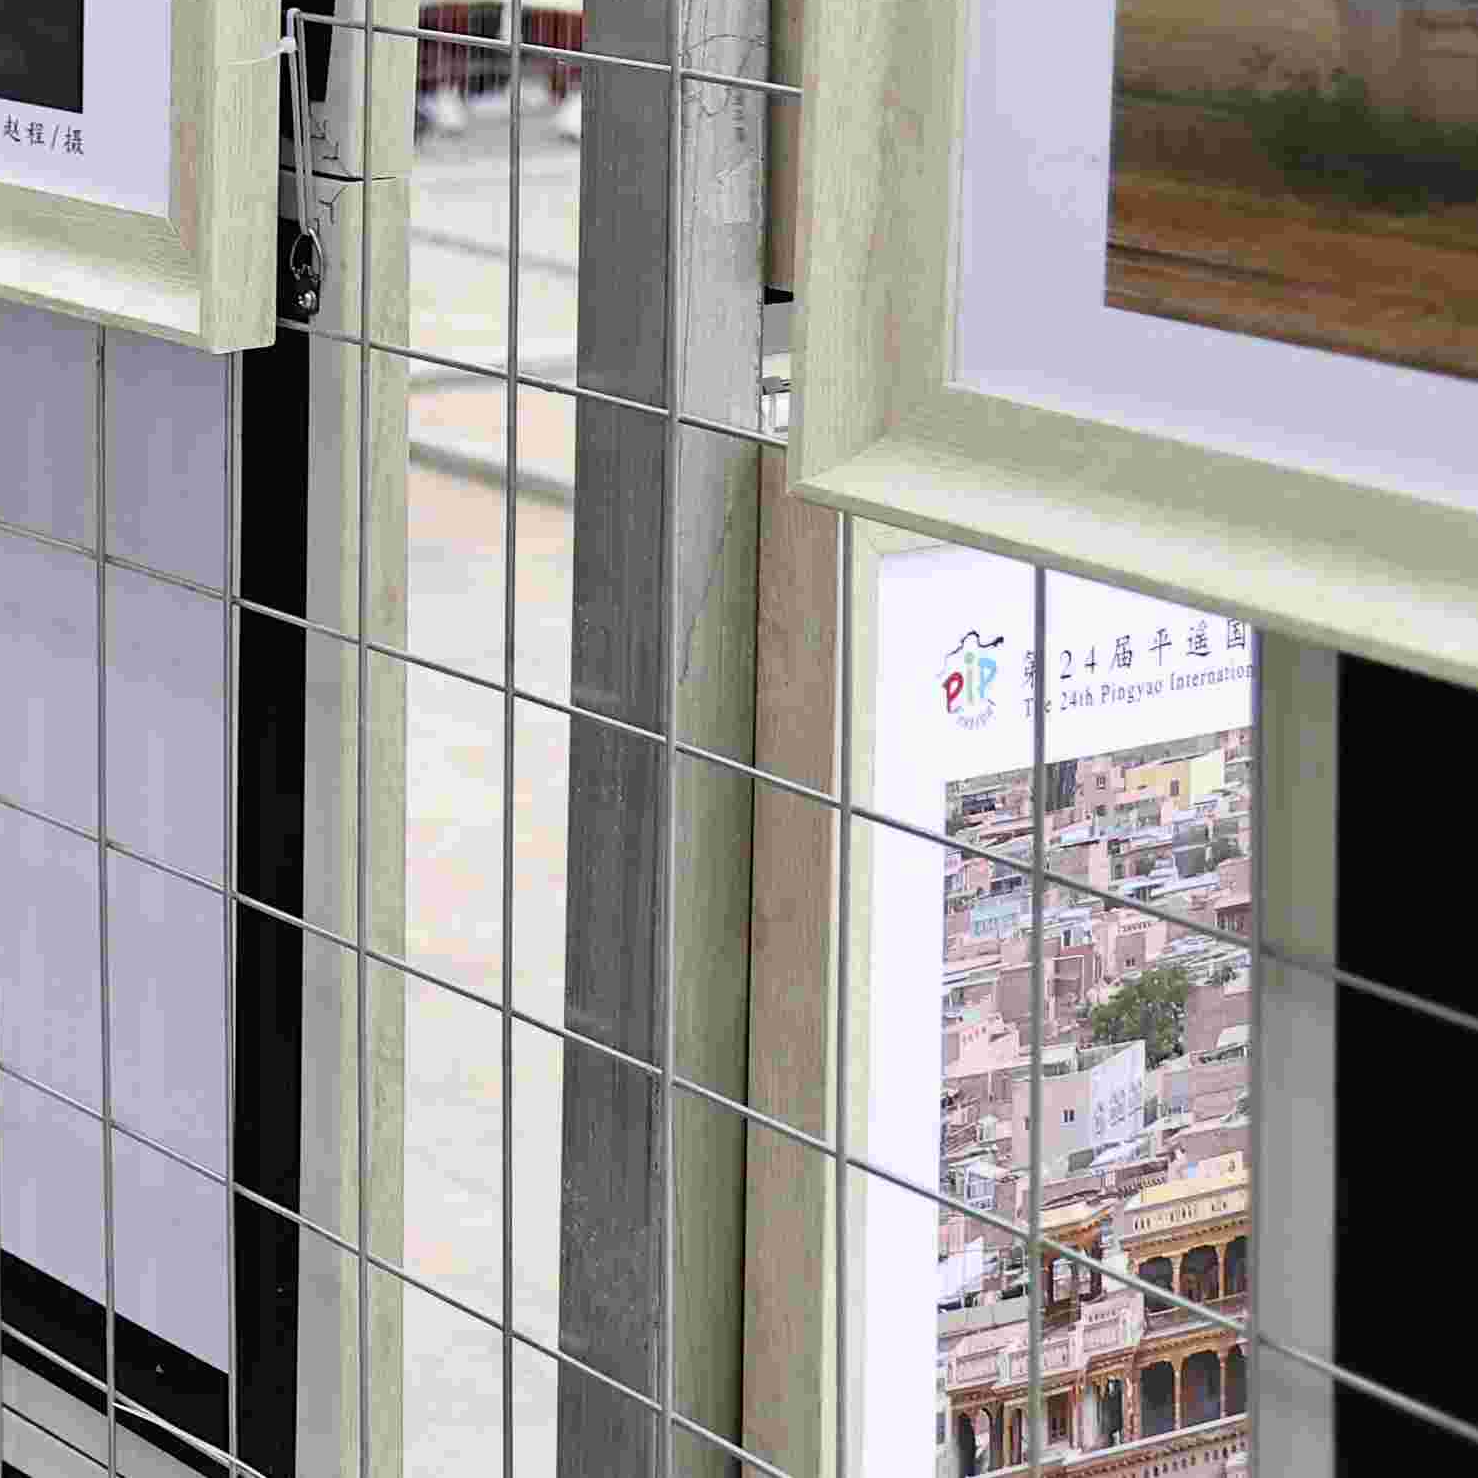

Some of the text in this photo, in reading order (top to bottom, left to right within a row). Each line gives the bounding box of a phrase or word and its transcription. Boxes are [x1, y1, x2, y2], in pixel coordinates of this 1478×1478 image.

[2, 113, 85, 156] 赵程/摄
[1022, 697, 1052, 719] Te
[1059, 685, 1093, 711] 24th
[1100, 680, 1164, 704] Pingyao
